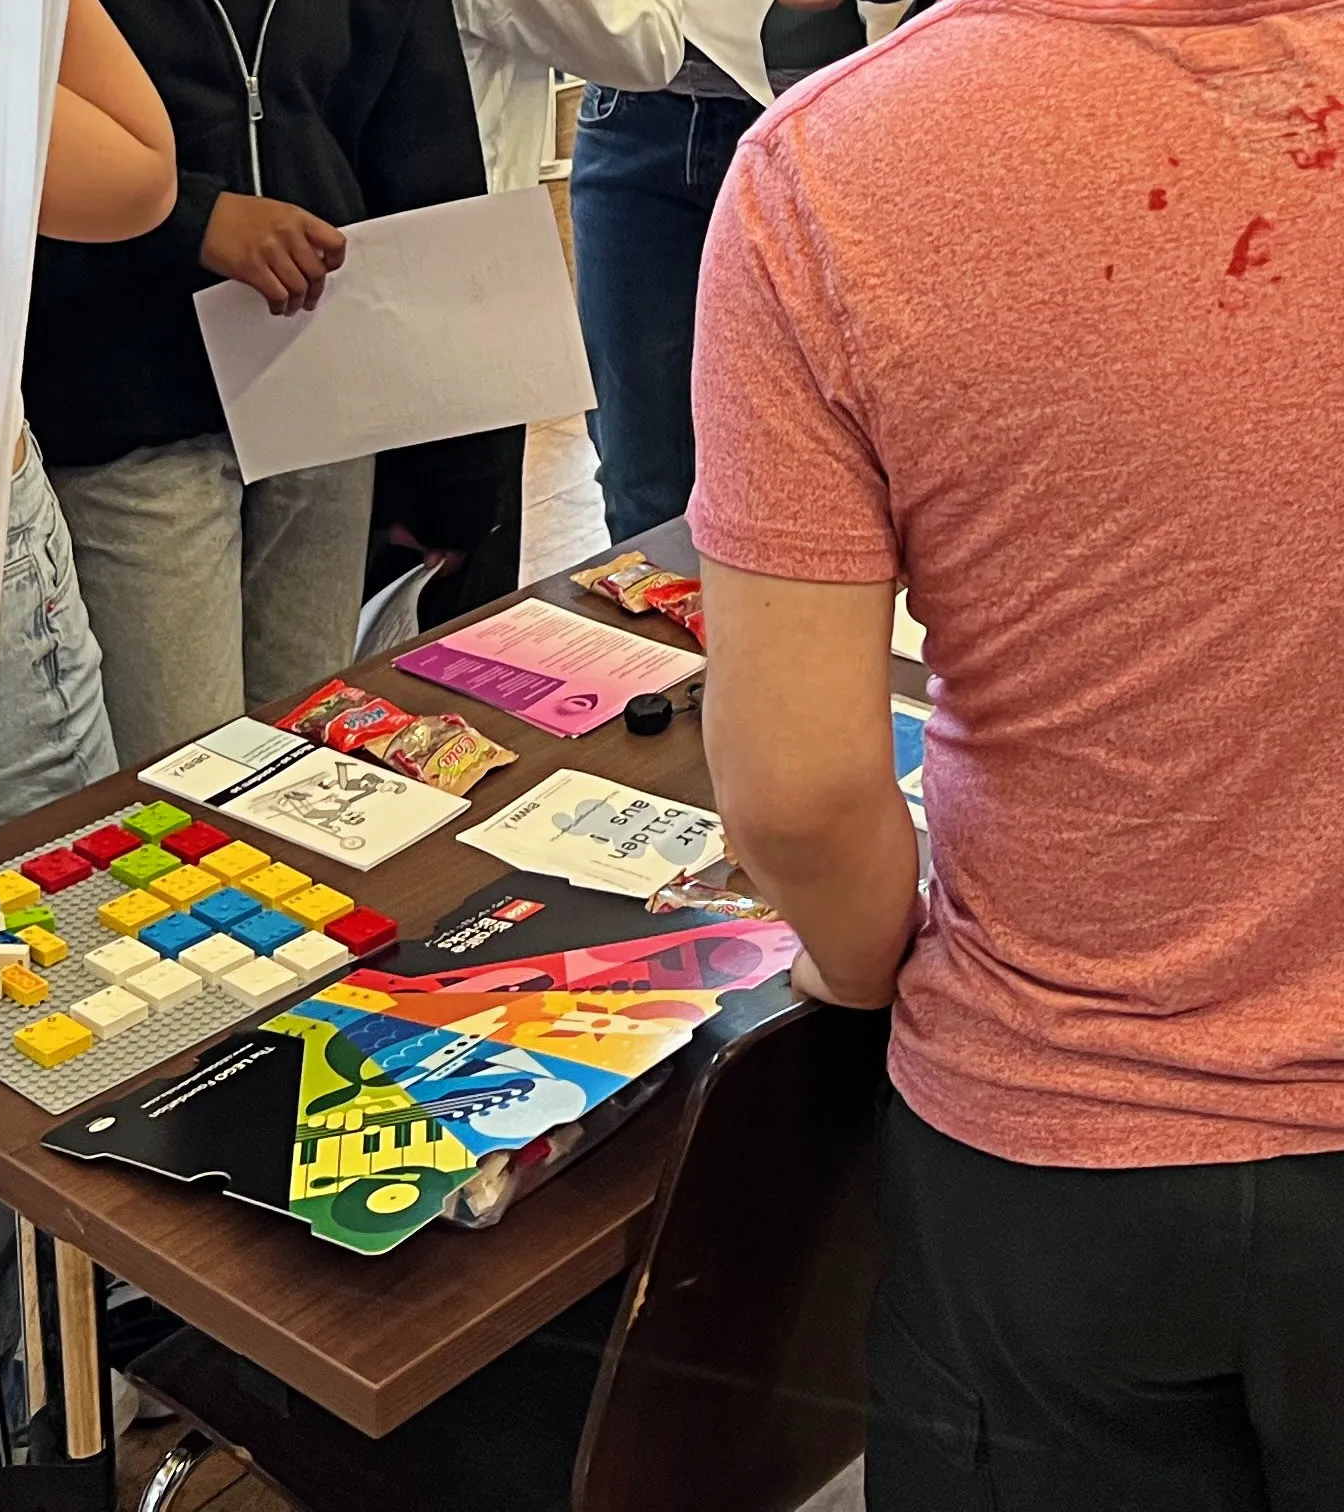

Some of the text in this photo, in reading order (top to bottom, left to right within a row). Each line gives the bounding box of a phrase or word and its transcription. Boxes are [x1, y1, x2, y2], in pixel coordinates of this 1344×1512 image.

[609, 798, 651, 827] aus
[607, 806, 692, 861] bilden
[675, 817, 723, 847] Wir
